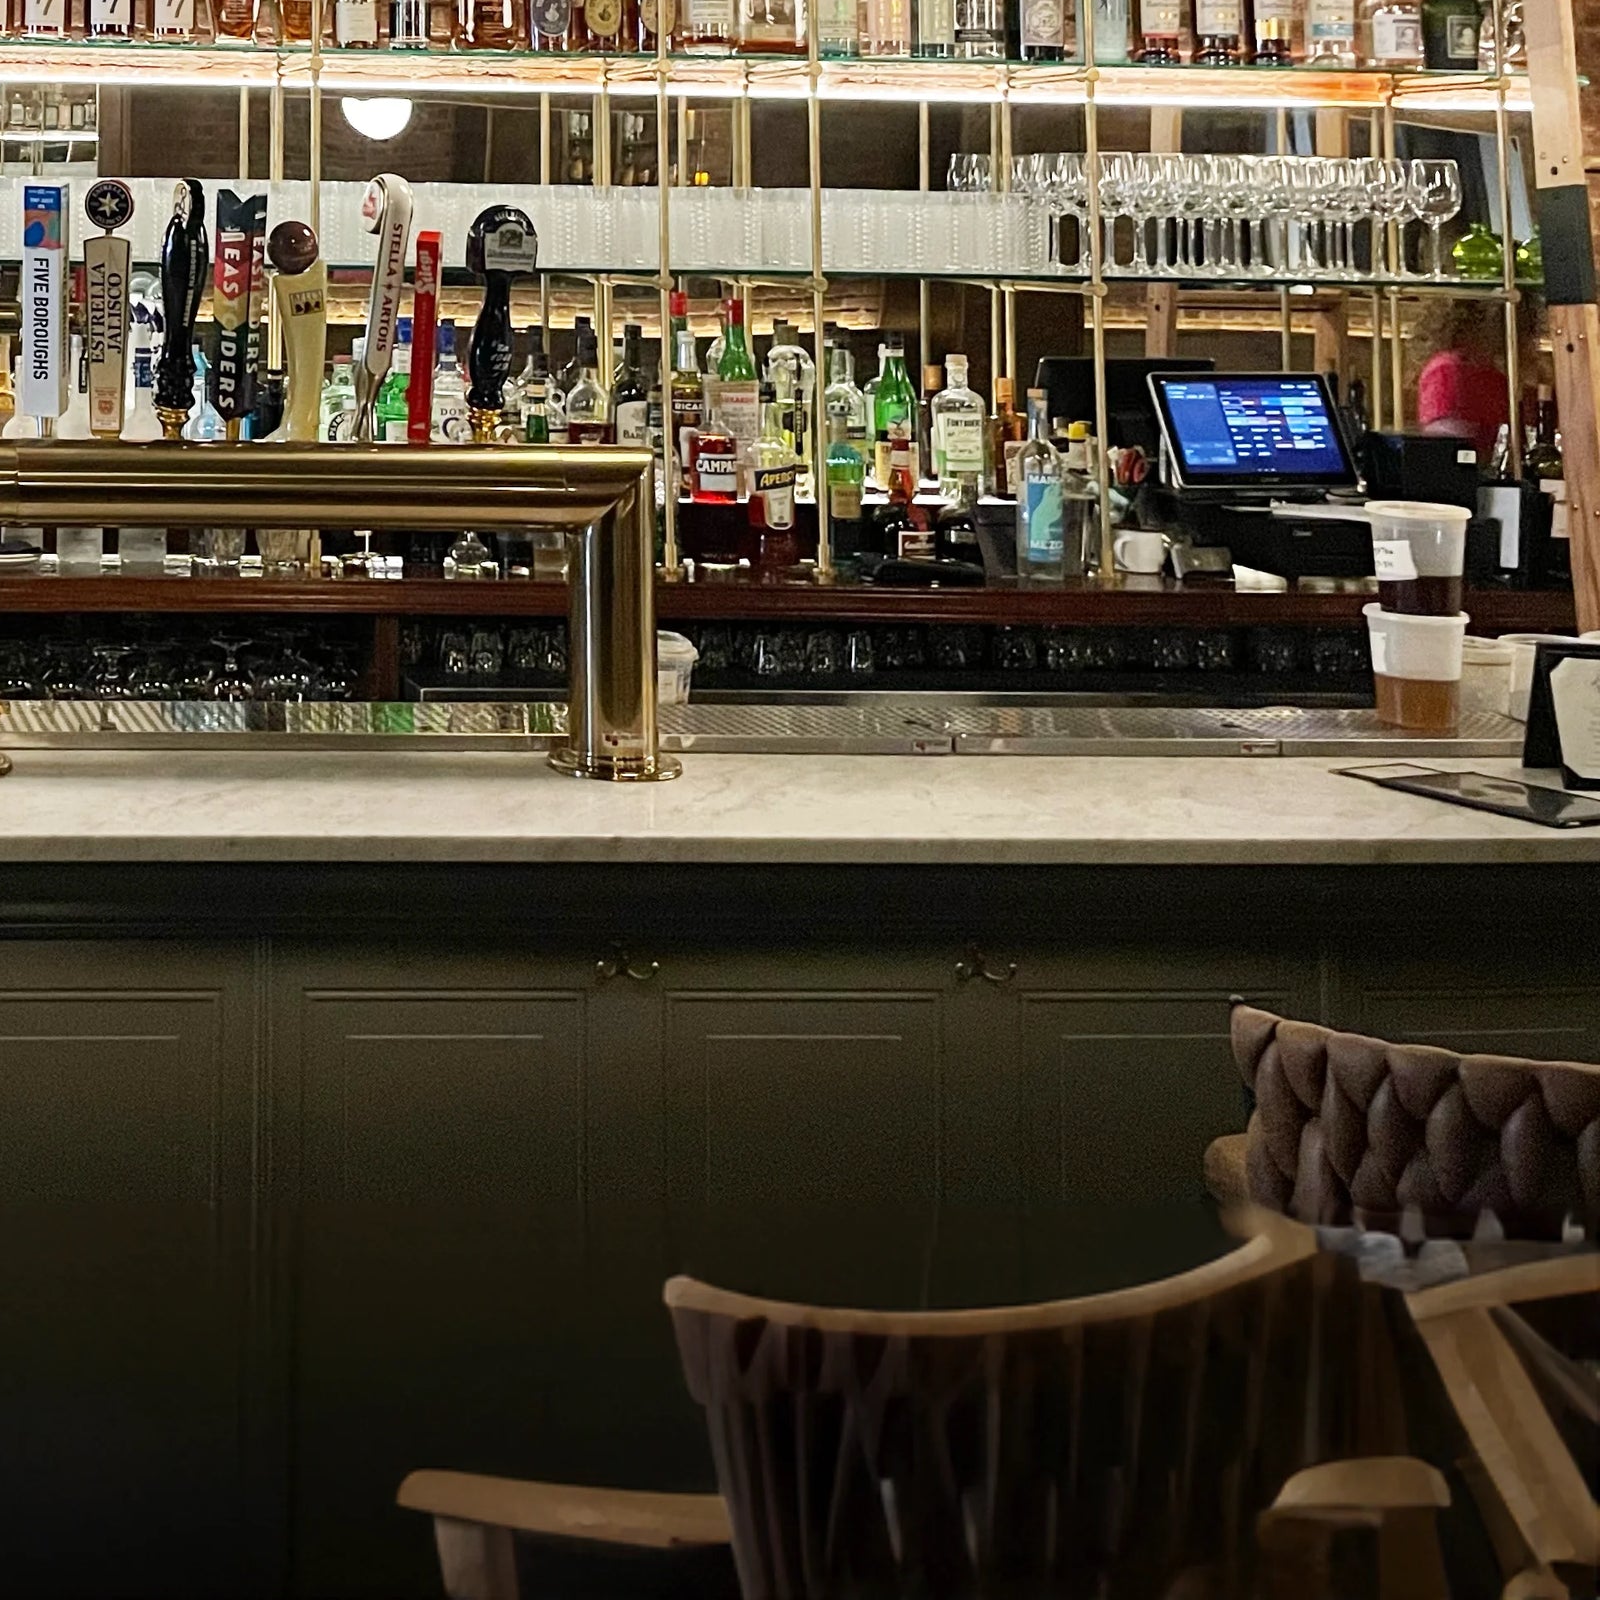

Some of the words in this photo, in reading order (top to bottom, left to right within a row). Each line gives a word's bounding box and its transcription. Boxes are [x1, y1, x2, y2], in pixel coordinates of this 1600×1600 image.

[33, 257, 49, 293] FIVE
[386, 223, 404, 277] STELLA
[33, 296, 49, 381] BOROUGHS
[91, 262, 106, 365] ESTRELLA
[107, 272, 123, 355] JALISCO
[376, 290, 393, 352] ARTOIS
